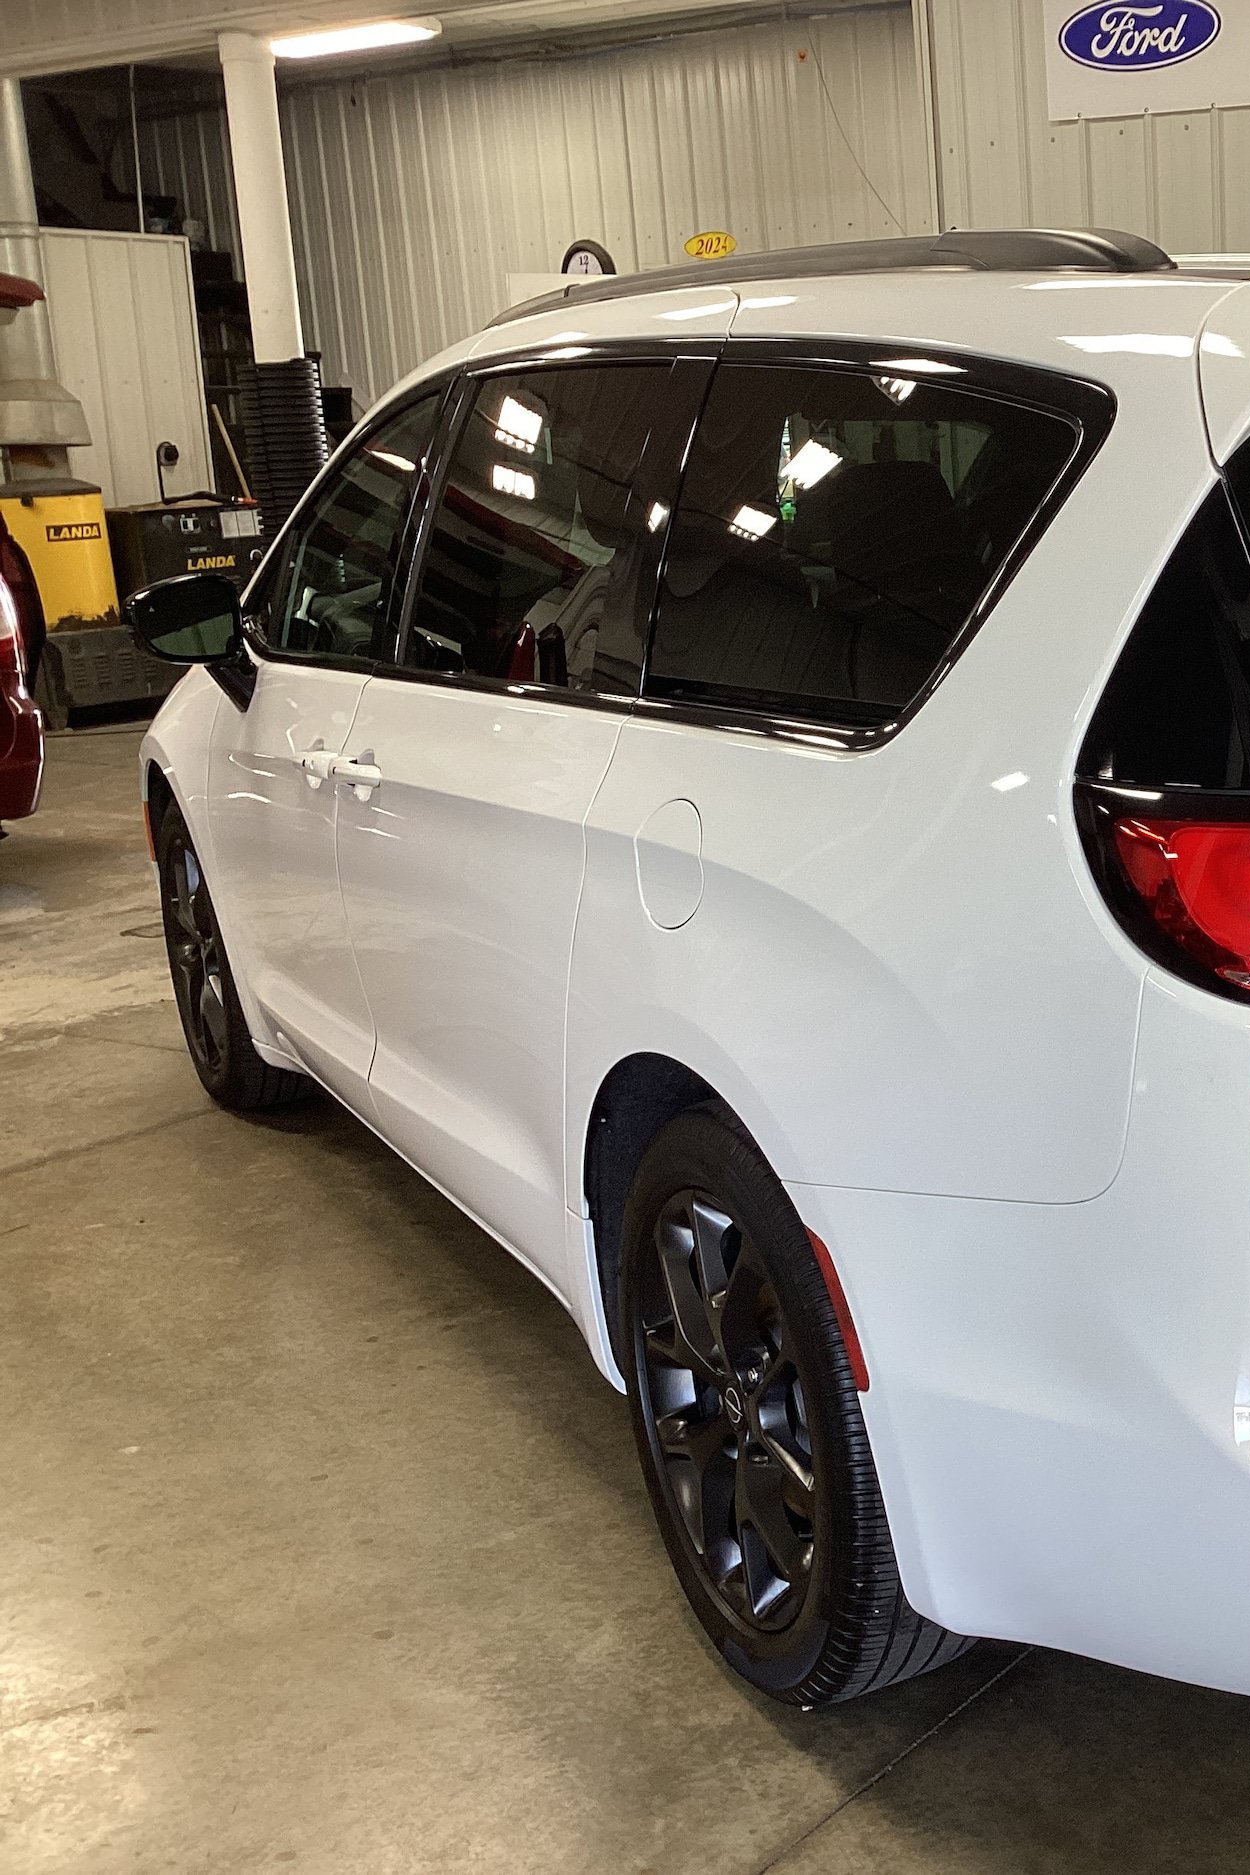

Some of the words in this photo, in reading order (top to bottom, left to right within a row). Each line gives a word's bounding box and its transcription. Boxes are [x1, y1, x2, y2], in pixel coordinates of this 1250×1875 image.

[1091, 4, 1187, 57] Ford
[579, 255, 589, 266] 12
[49, 524, 99, 540] LANDA
[187, 555, 235, 571] LANDA
